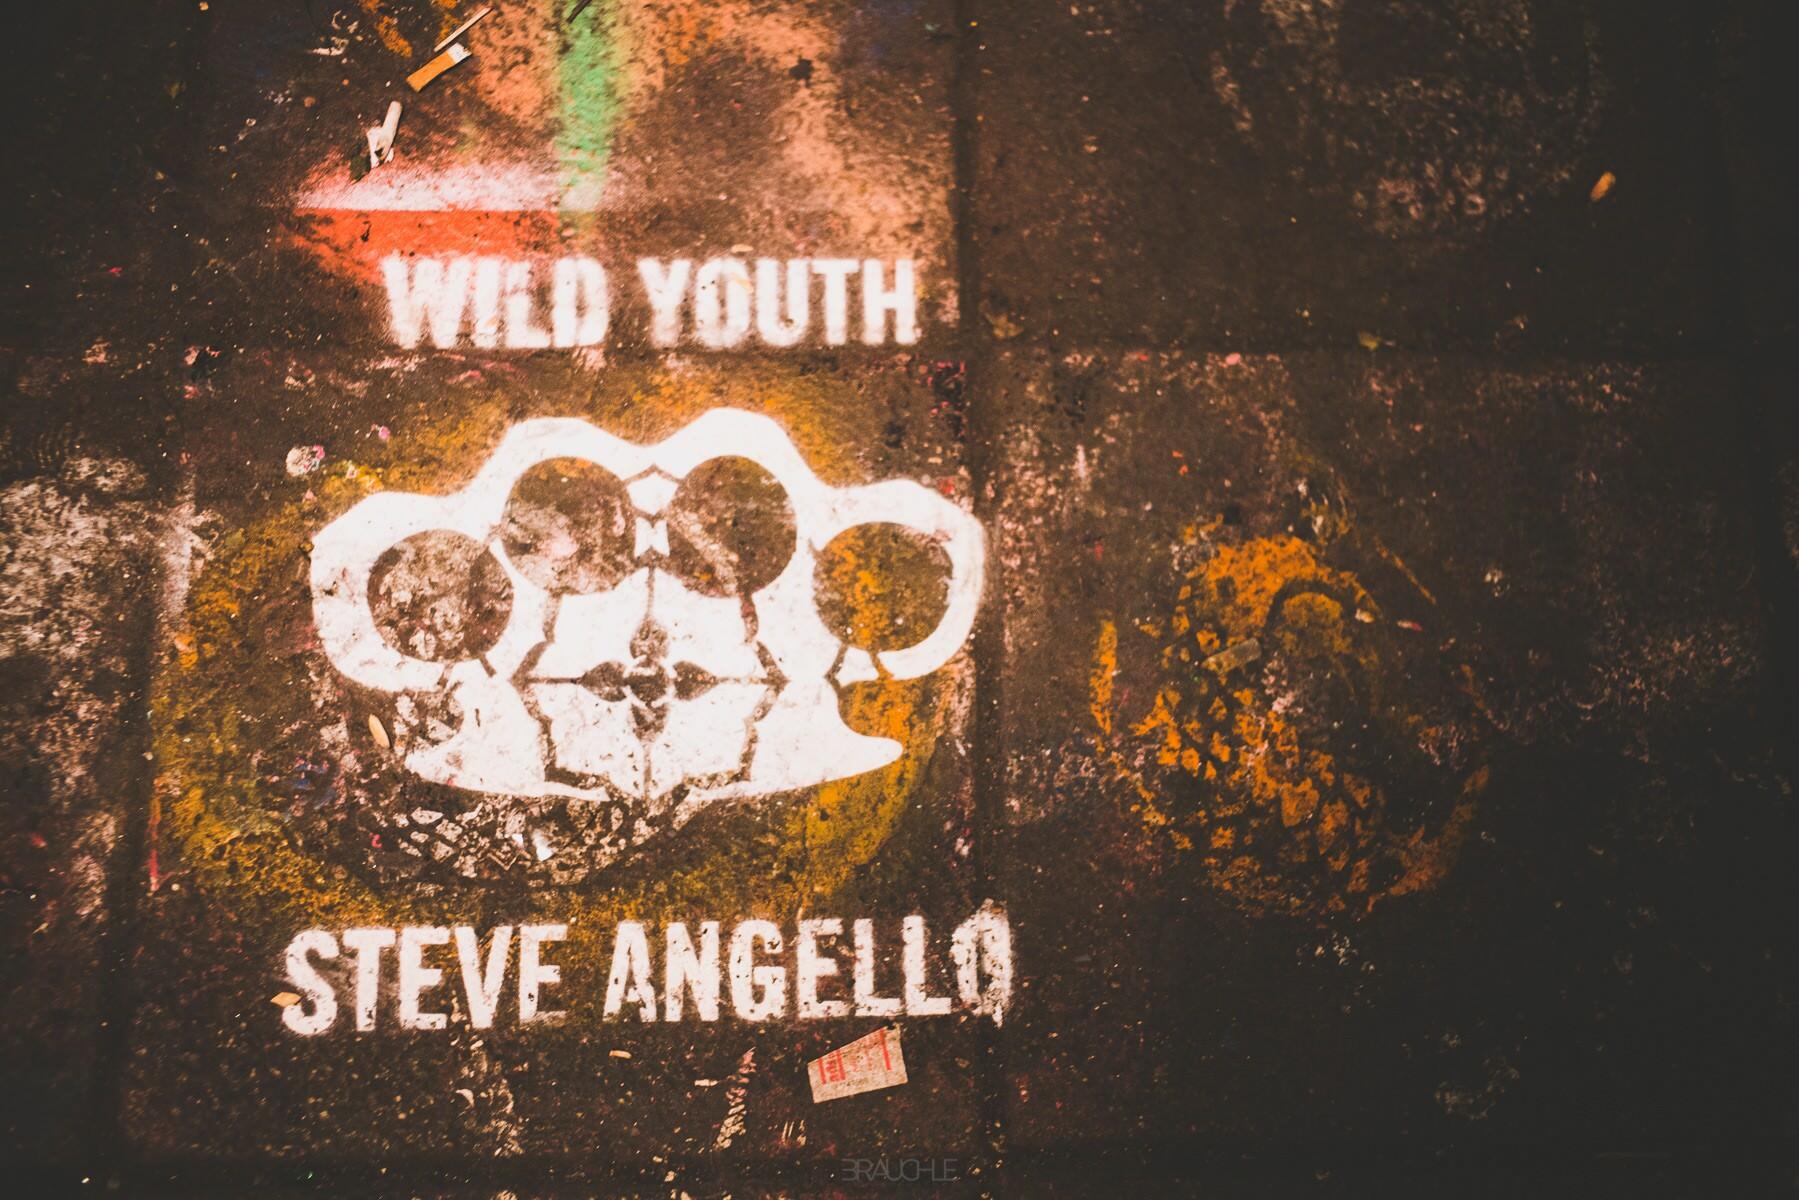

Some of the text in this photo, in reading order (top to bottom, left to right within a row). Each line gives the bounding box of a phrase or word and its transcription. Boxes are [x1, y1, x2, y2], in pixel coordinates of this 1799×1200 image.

[382, 255, 919, 347] WILD YOUTH
[281, 899, 1013, 1037] STEVE ANGELLO
